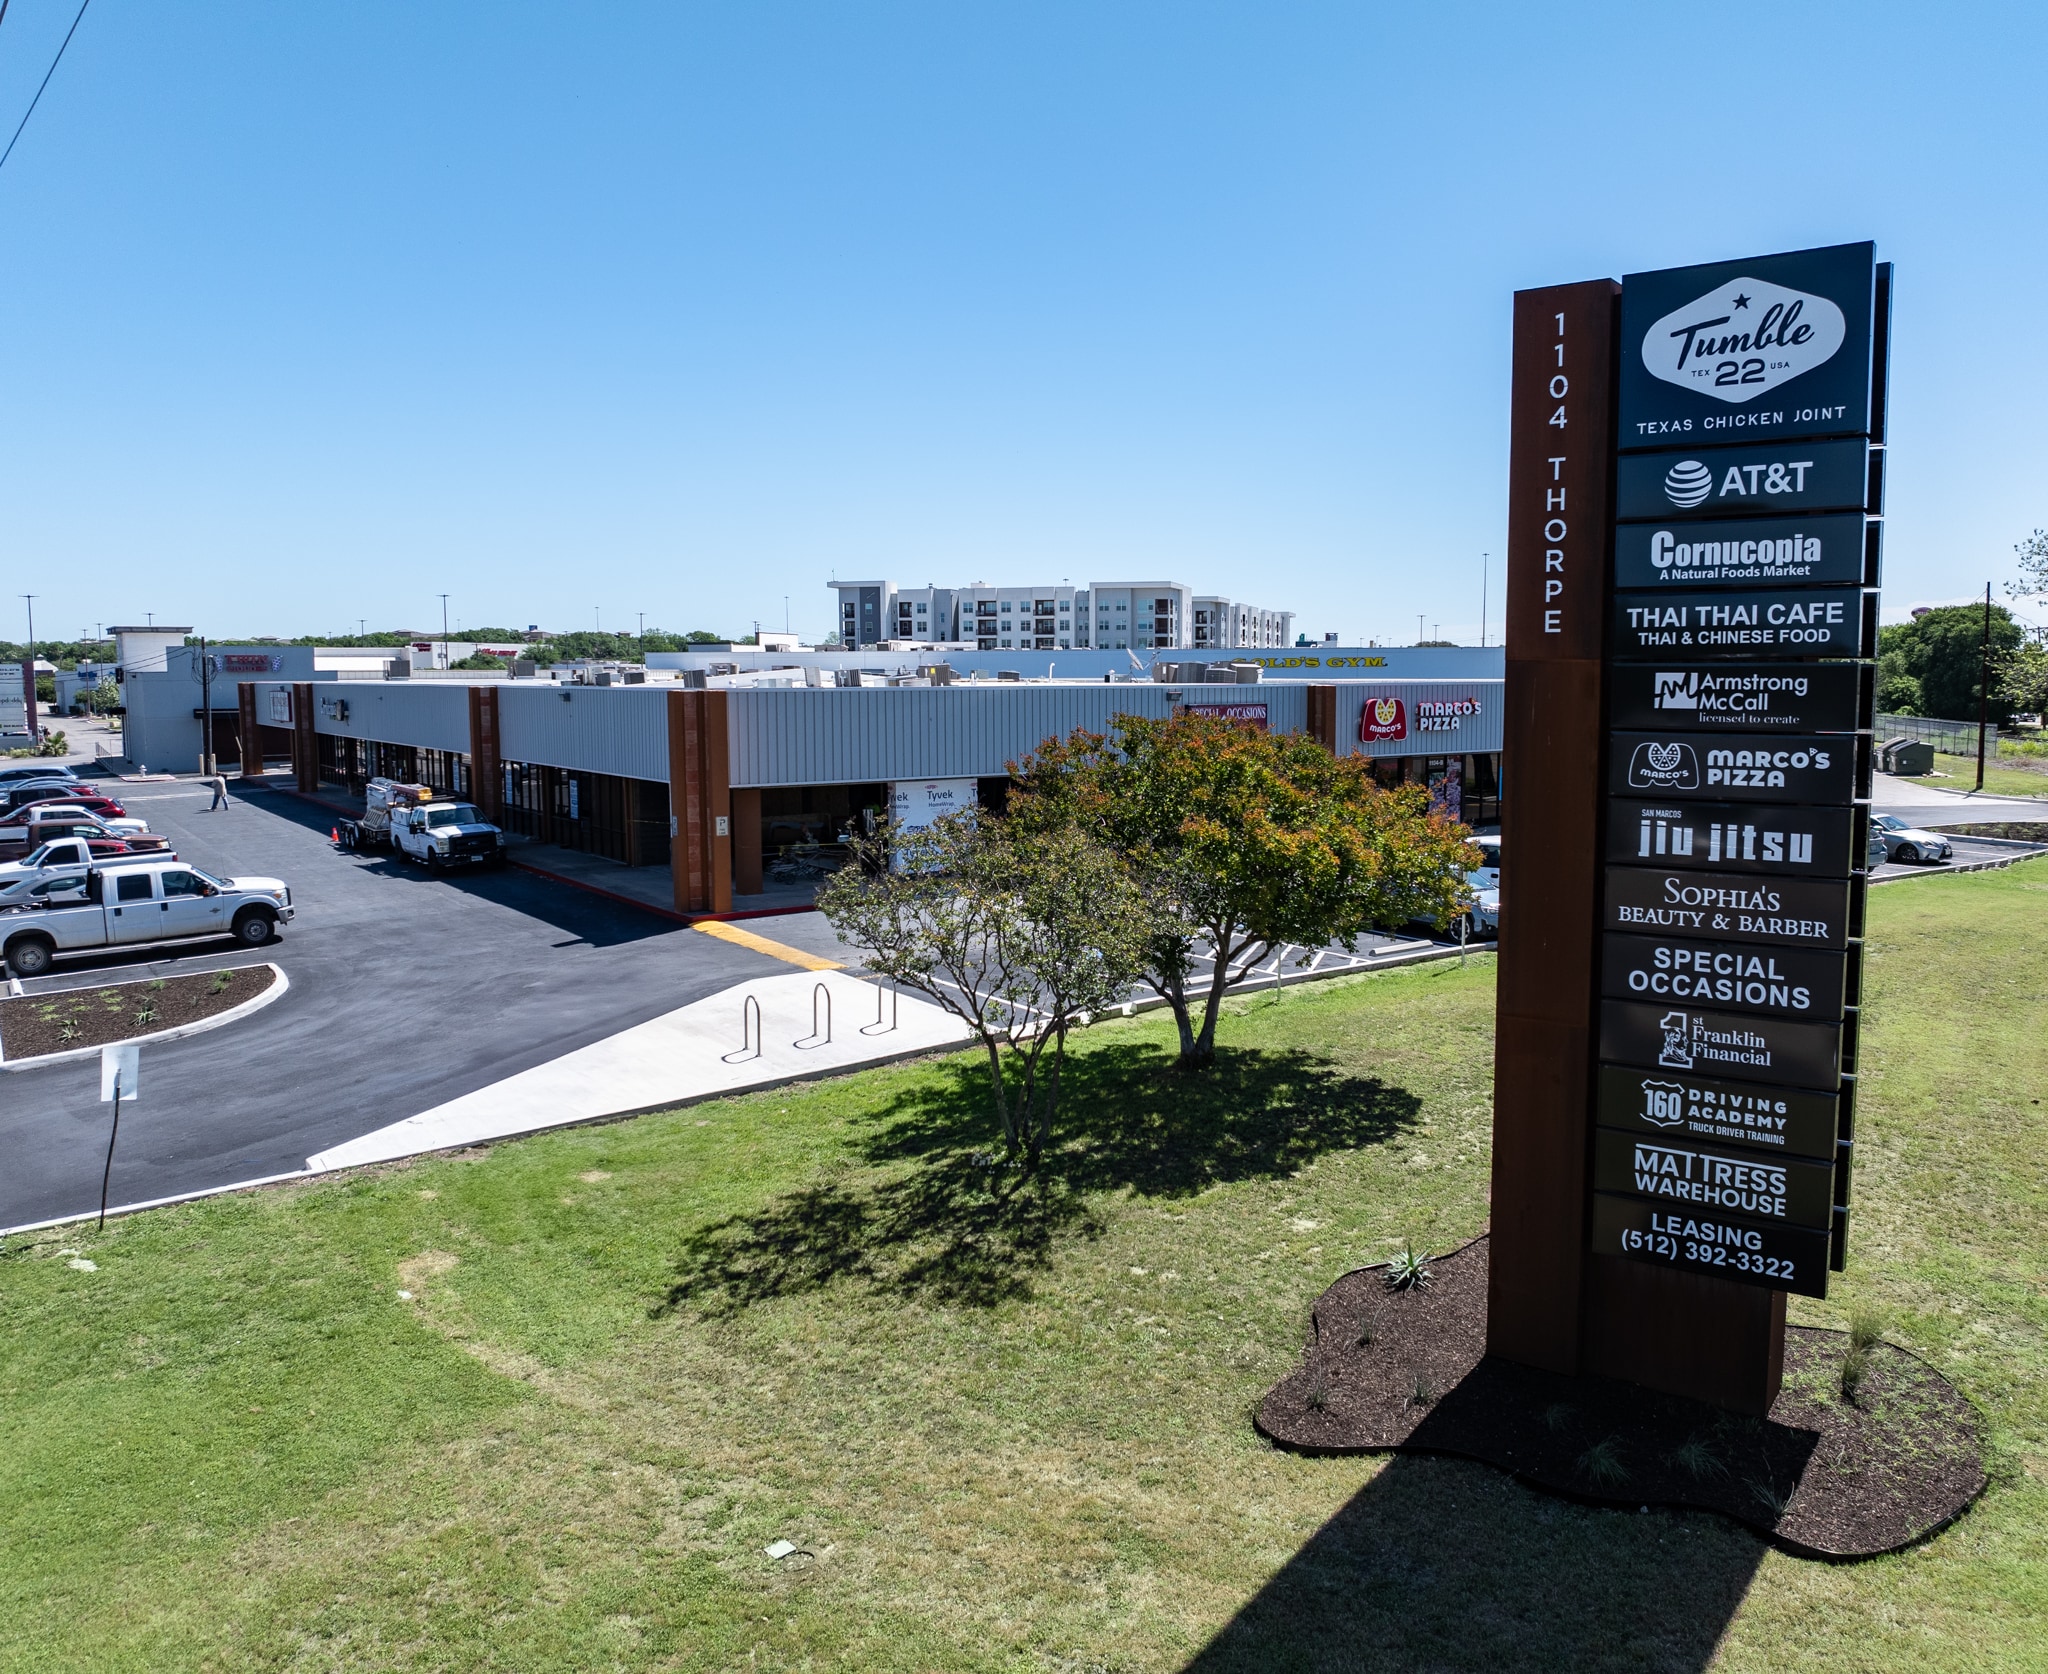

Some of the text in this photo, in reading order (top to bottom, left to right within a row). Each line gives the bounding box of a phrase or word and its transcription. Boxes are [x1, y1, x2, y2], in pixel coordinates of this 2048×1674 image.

[1670, 299, 1815, 370] Tumble
[1691, 358, 1790, 386] TEX 22 USA
[1637, 406, 1846, 435] TEXAS CHICKEN JOINT
[1544, 312, 1568, 633] 1104 THORPE
[1719, 461, 1813, 497] AT&T
[1651, 530, 1821, 568] Cornucopia
[1659, 565, 1811, 580] A Natural Foods Market
[1627, 602, 1844, 628] THAI THAI CAFE
[1638, 628, 1831, 645] THAI & CHINESE FOOD
[1700, 673, 1808, 697] Armstrong
[1226, 707, 1267, 719] OCCASIONS
[1420, 699, 1482, 716] MARCO'S
[1699, 693, 1768, 710] McCall
[1369, 723, 1402, 733] MARCO'S
[1419, 717, 1460, 731] PIZZA
[1699, 712, 1800, 725] licensed to create
[1707, 747, 1830, 770] MARCO'S
[1640, 768, 1690, 779] MARCO'S
[1707, 769, 1785, 788] PIZZA
[927, 790, 953, 801] Tyvek
[1641, 808, 1682, 819] SAN MARCOS
[1638, 820, 1812, 863] jiu jitsu
[1664, 877, 1781, 912] SOPHIA'S
[1618, 906, 1829, 939] BEAUTY & BARBER
[1653, 947, 1785, 981] SPECIAL
[1628, 970, 1811, 1009] OCCASIONS
[1691, 1025, 1766, 1049] Franklin
[1691, 1042, 1772, 1067] Financial
[1644, 1088, 1682, 1121] 160
[1688, 1088, 1787, 1114] DRIVING
[1688, 1105, 1787, 1131] ACADEMY
[1688, 1121, 1785, 1145] TRUCK DRIVER TRAINING
[1634, 1143, 1787, 1195] MATTRESS
[1634, 1172, 1786, 1217] WAREHOUSE
[1652, 1213, 1762, 1250] LEASING
[1621, 1229, 1795, 1280] (512) 392-3322
